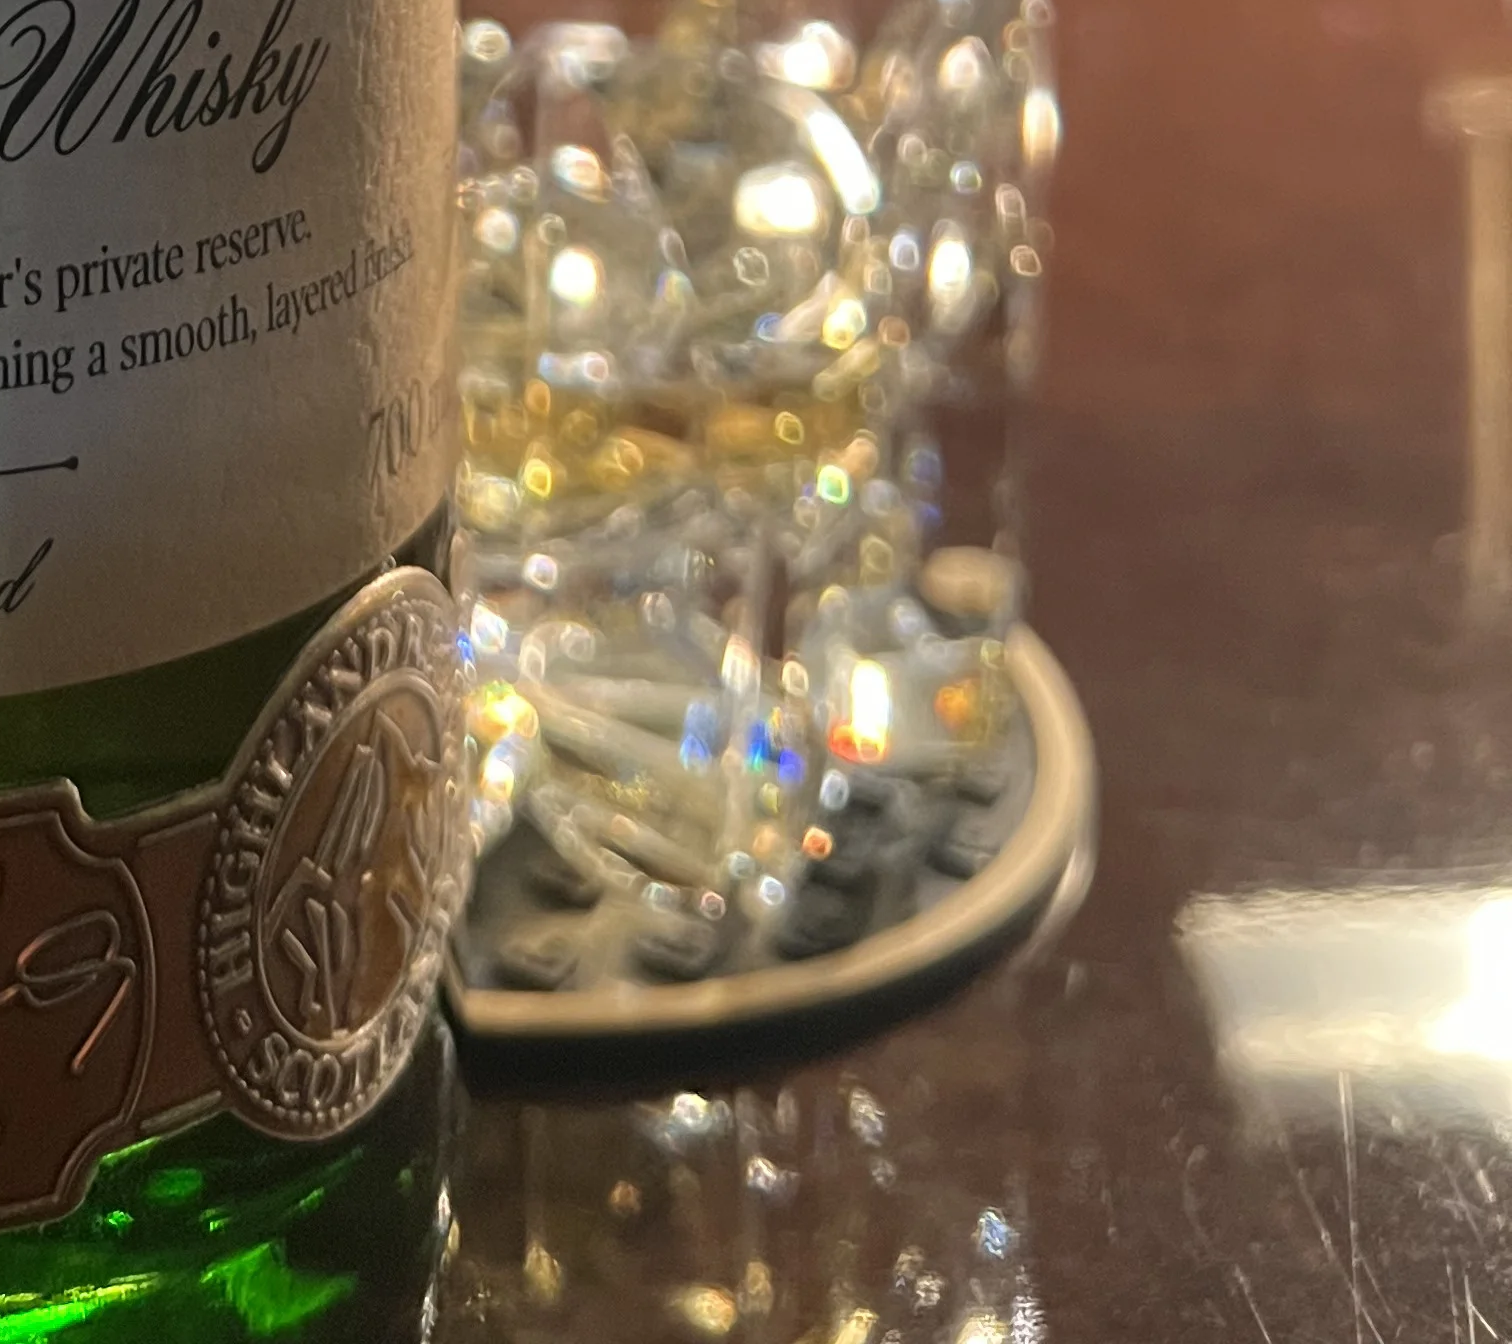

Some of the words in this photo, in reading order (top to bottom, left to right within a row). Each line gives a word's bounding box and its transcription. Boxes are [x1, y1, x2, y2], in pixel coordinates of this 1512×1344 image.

[55, 242, 185, 312] private
[193, 208, 313, 275] reserve.
[87, 339, 110, 378] a
[119, 292, 258, 373] smooth,
[266, 246, 357, 336] layered
